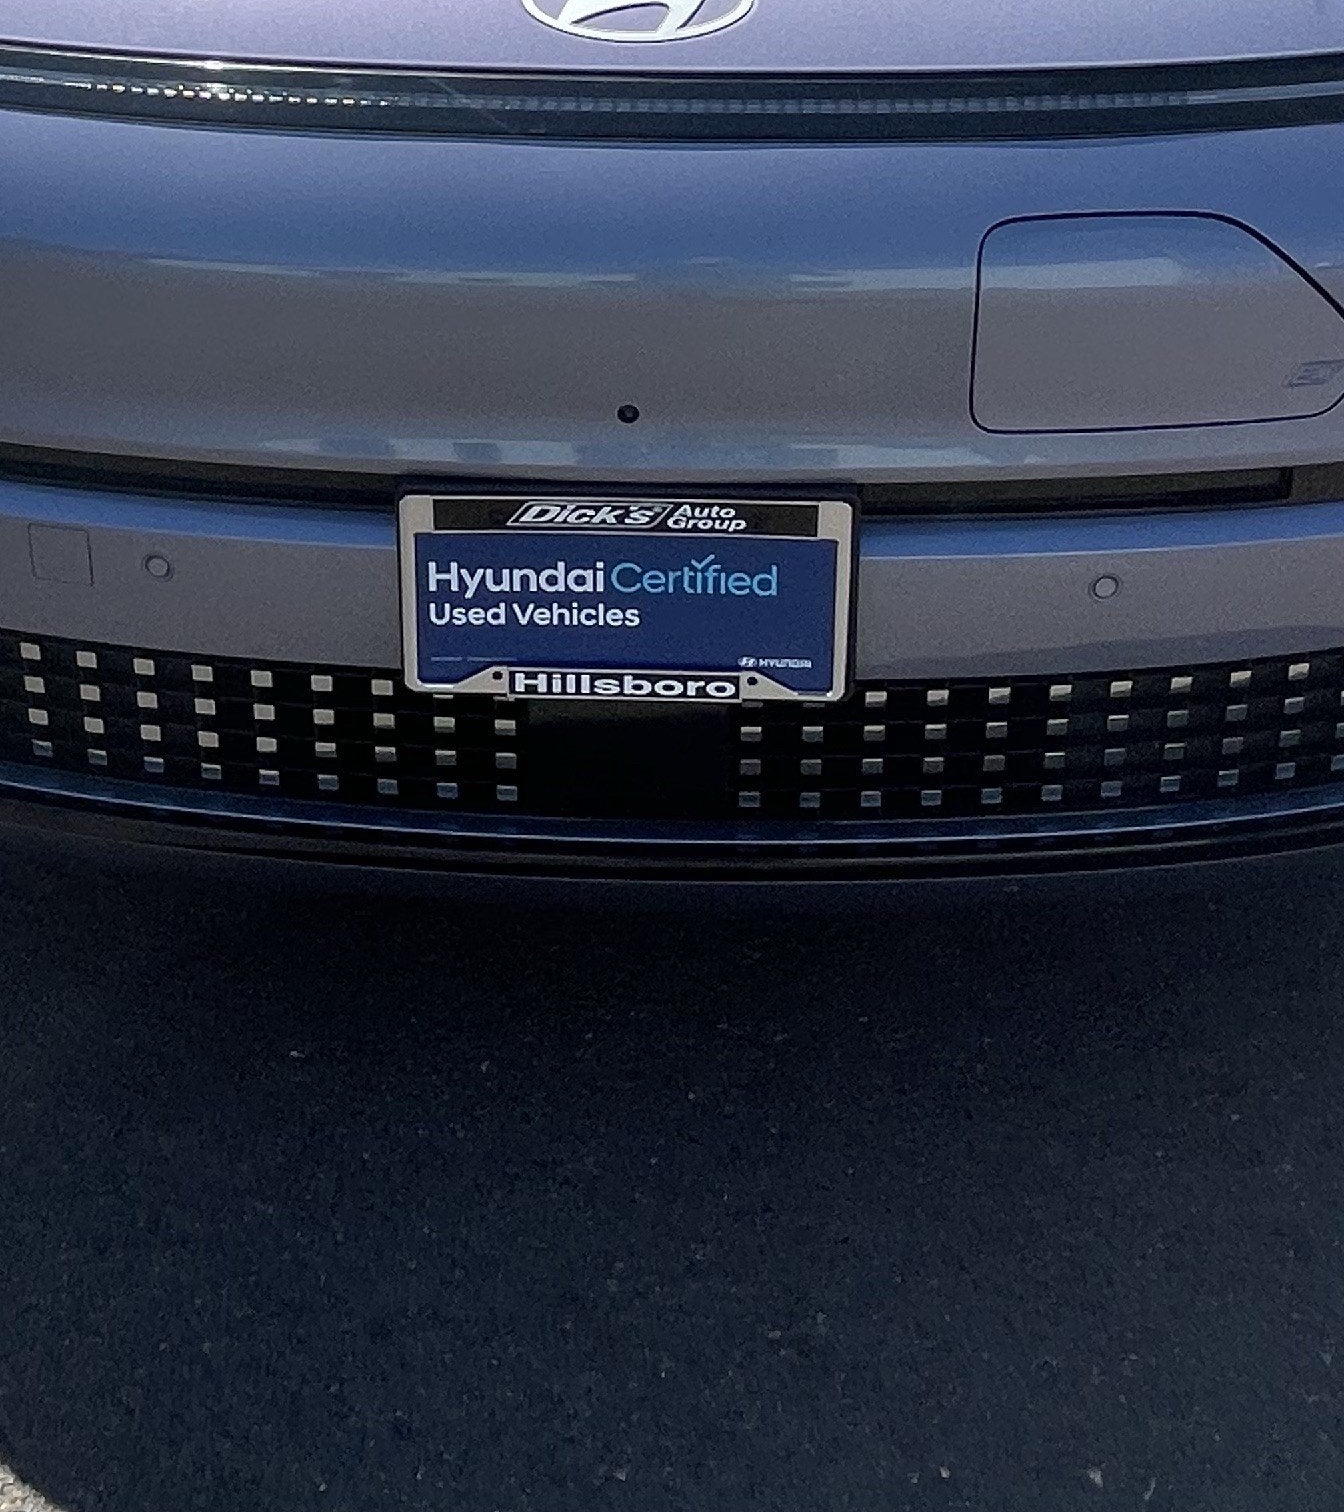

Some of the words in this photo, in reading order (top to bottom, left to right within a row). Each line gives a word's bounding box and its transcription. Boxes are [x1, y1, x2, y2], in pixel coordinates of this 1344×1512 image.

[517, 502, 660, 527] Dick's
[666, 515, 748, 533] Group
[667, 504, 737, 520] Auto
[427, 560, 605, 599] Hyundai
[610, 555, 778, 597] Certified
[428, 602, 506, 627] Used
[512, 602, 641, 627] Vehicles
[514, 672, 737, 698] Hillsboro
